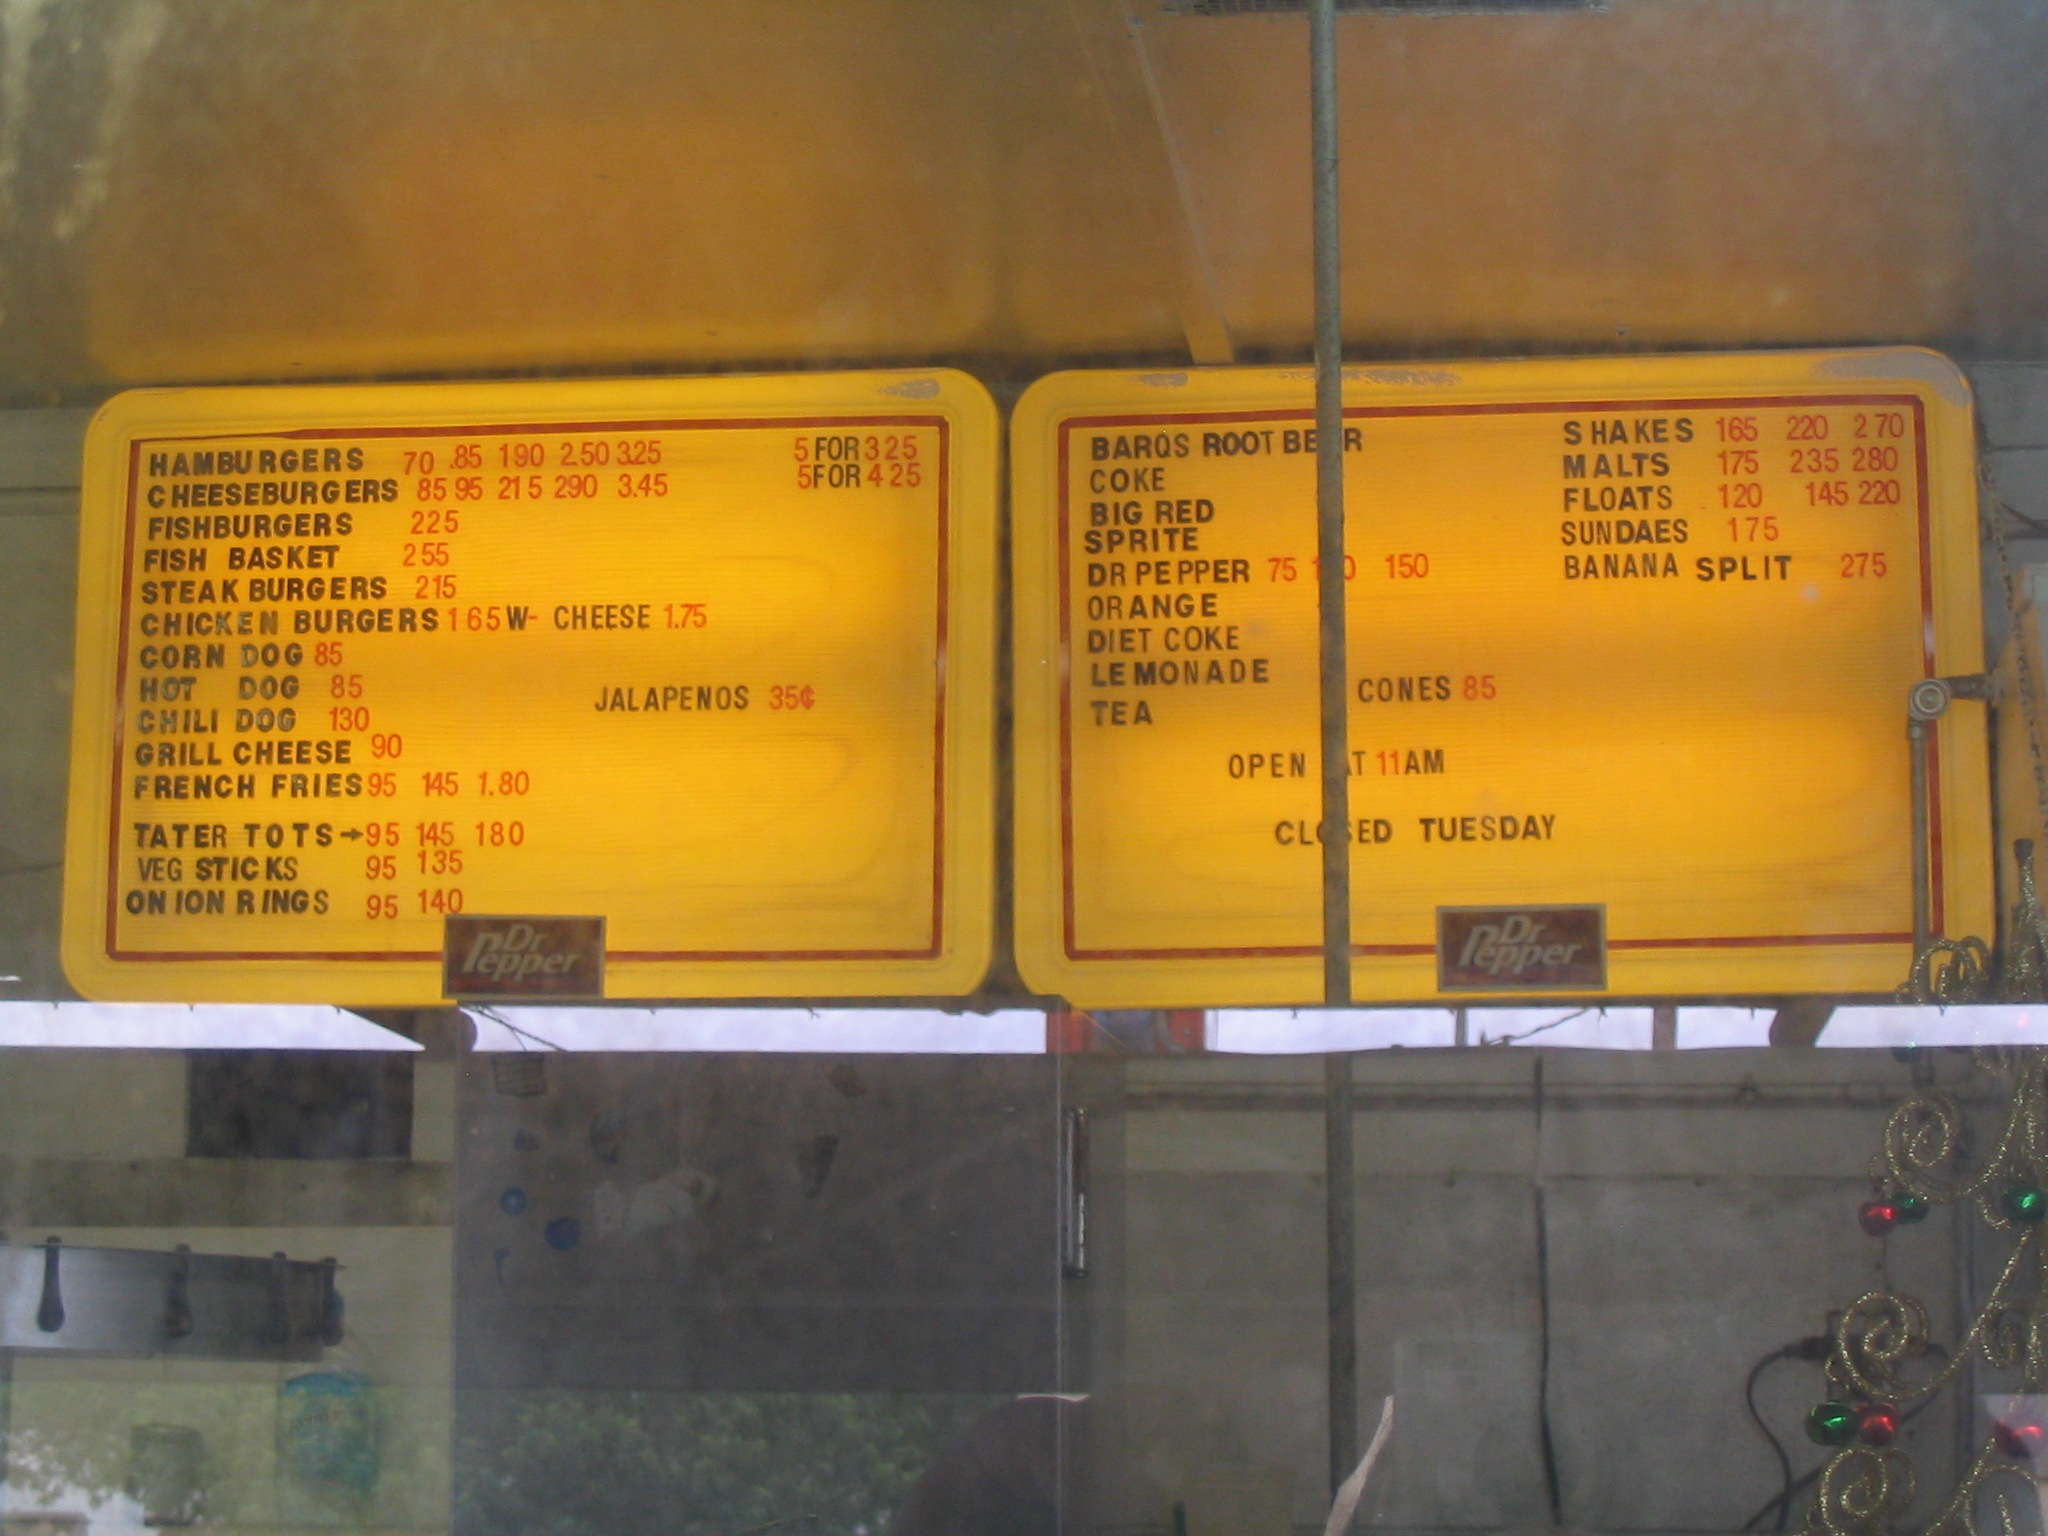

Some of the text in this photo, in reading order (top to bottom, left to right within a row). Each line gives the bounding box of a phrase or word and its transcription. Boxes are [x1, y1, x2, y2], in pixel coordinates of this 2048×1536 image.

[1564, 412, 1904, 445] SHAKES 165 220 270
[150, 447, 364, 477] HAMBURGERS
[404, 451, 434, 475] 70
[450, 445, 482, 469] .85
[499, 443, 544, 468] 190
[815, 436, 859, 461] FOR
[865, 435, 917, 460] 325
[1091, 427, 1362, 460] BARQS ROOT BER
[1563, 446, 1898, 479] MALTS 175 235 280
[147, 479, 399, 508] CHEESEBURGERS
[417, 477, 446, 501] 85
[455, 476, 482, 500] 95
[498, 475, 543, 500] 215
[554, 474, 597, 498] 290
[617, 473, 668, 497] 3.45
[867, 463, 921, 487] 425
[1090, 467, 1165, 493] COKE
[1564, 479, 1901, 512] FLOATS 120 145 220
[148, 510, 459, 540] FISHBURGERS 225
[1091, 499, 1215, 527] BIG RED
[1085, 527, 1198, 554] SPRITE
[1561, 516, 1779, 546] SUNDAES 175
[144, 542, 449, 572] FISH BASKET 255
[1088, 562, 1126, 587] DR
[1136, 558, 1250, 585] PEPPER
[1268, 557, 1297, 583] 75
[1385, 553, 1429, 579] 150
[1565, 552, 1887, 582] BANANA SPLIT 275
[416, 575, 456, 599] 215
[141, 611, 278, 637] CHICKEN
[294, 607, 439, 634] BURGERS
[448, 606, 500, 631] 165
[554, 604, 650, 631] CHEESE
[664, 603, 707, 629] 1.75
[1087, 593, 1218, 621] ORANGE
[1088, 626, 1239, 654] DIET COKE
[140, 642, 343, 669] CORN DOG 85
[140, 674, 363, 701] HOT DOG 85
[1091, 659, 1269, 688] LEMONADE
[594, 685, 815, 712] JALAPENOS 35¢
[1358, 675, 1497, 702] CONES 85
[137, 706, 370, 734] CHILI DOG 130
[1091, 701, 1153, 727] TEA
[135, 734, 402, 767] GRILL CHEESE 90
[1229, 753, 1305, 779] OPEN
[134, 771, 529, 799] FRENCH FRIES 95 145 1.80
[134, 821, 524, 848] TATER TOTS 95 145 180
[1419, 814, 1556, 842] TUESDAY
[138, 850, 463, 881] VEG STICKS 95 135
[126, 888, 463, 919] ONION RINGS 95 140
[504, 923, 548, 949] Dr
[1500, 915, 1545, 944] Dr
[461, 930, 580, 981] Pepper
[1458, 924, 1582, 975] Pepper
